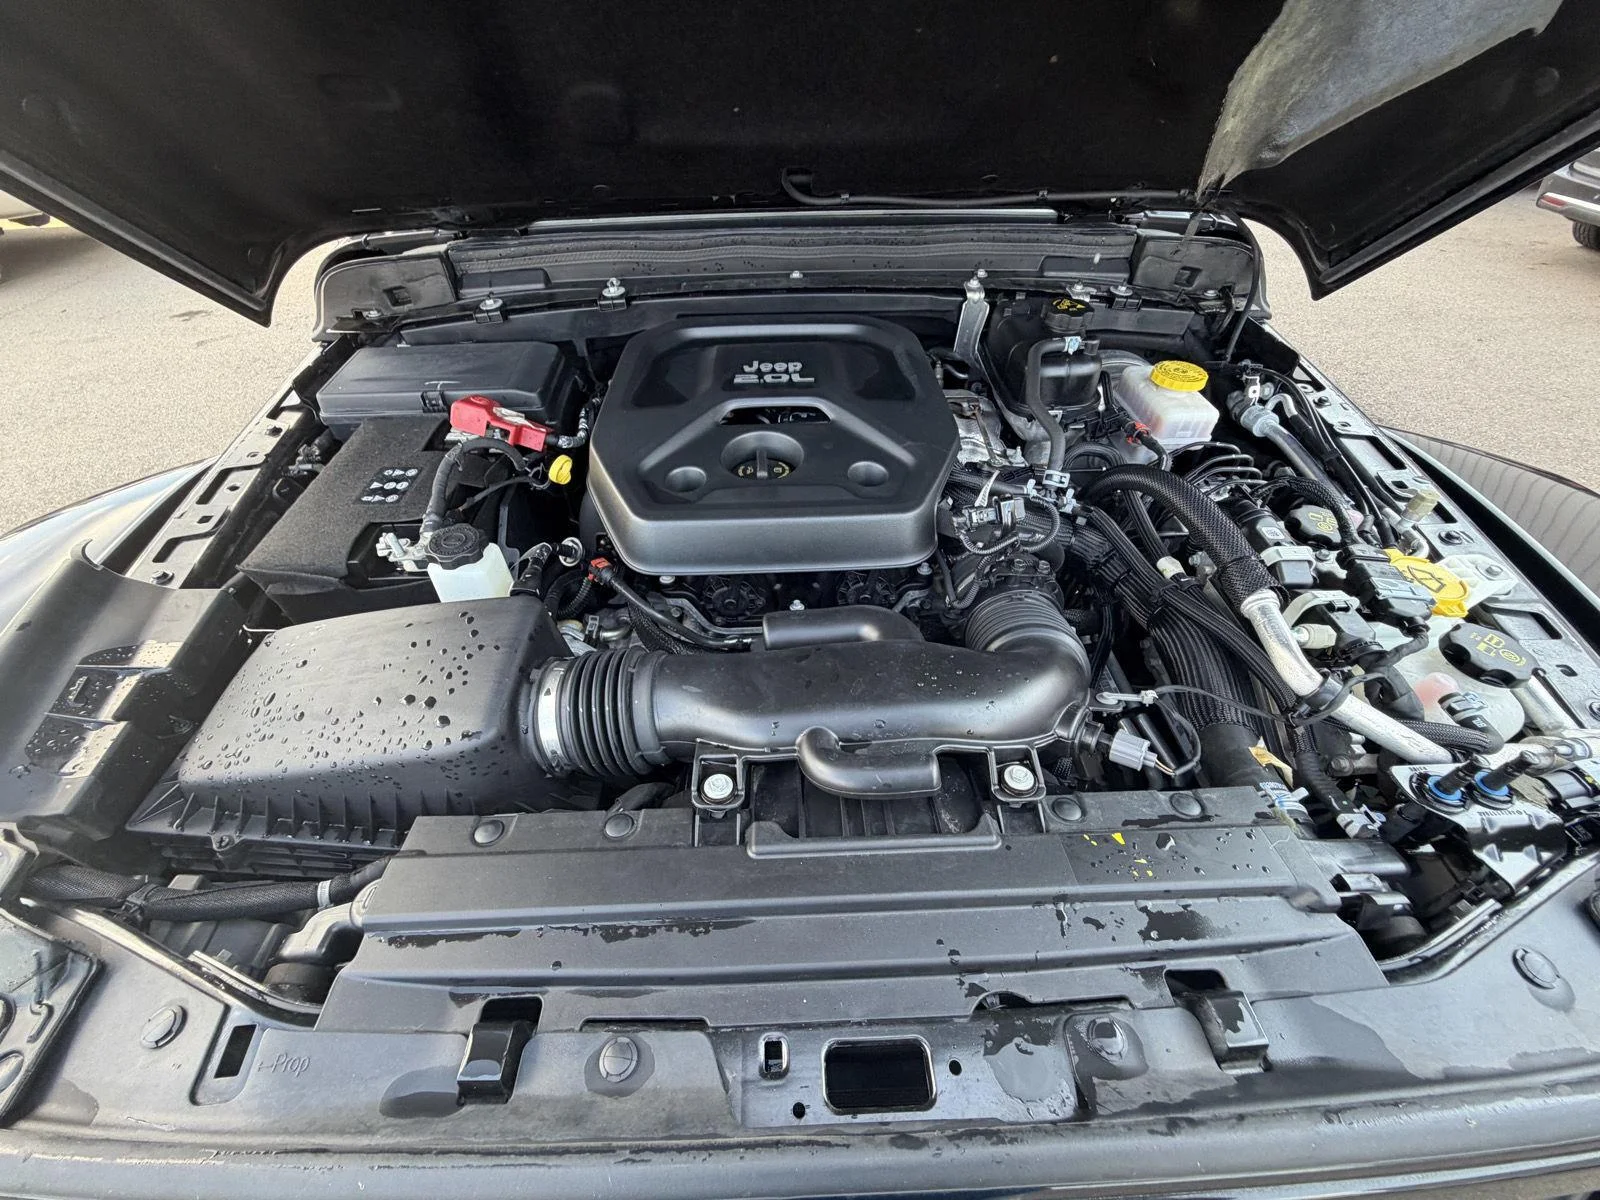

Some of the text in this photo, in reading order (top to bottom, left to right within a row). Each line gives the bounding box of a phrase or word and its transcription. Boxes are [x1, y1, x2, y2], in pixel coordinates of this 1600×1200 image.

[743, 360, 802, 373] Jeep
[733, 373, 815, 384] 2.0L
[271, 1052, 310, 1078] Prop
